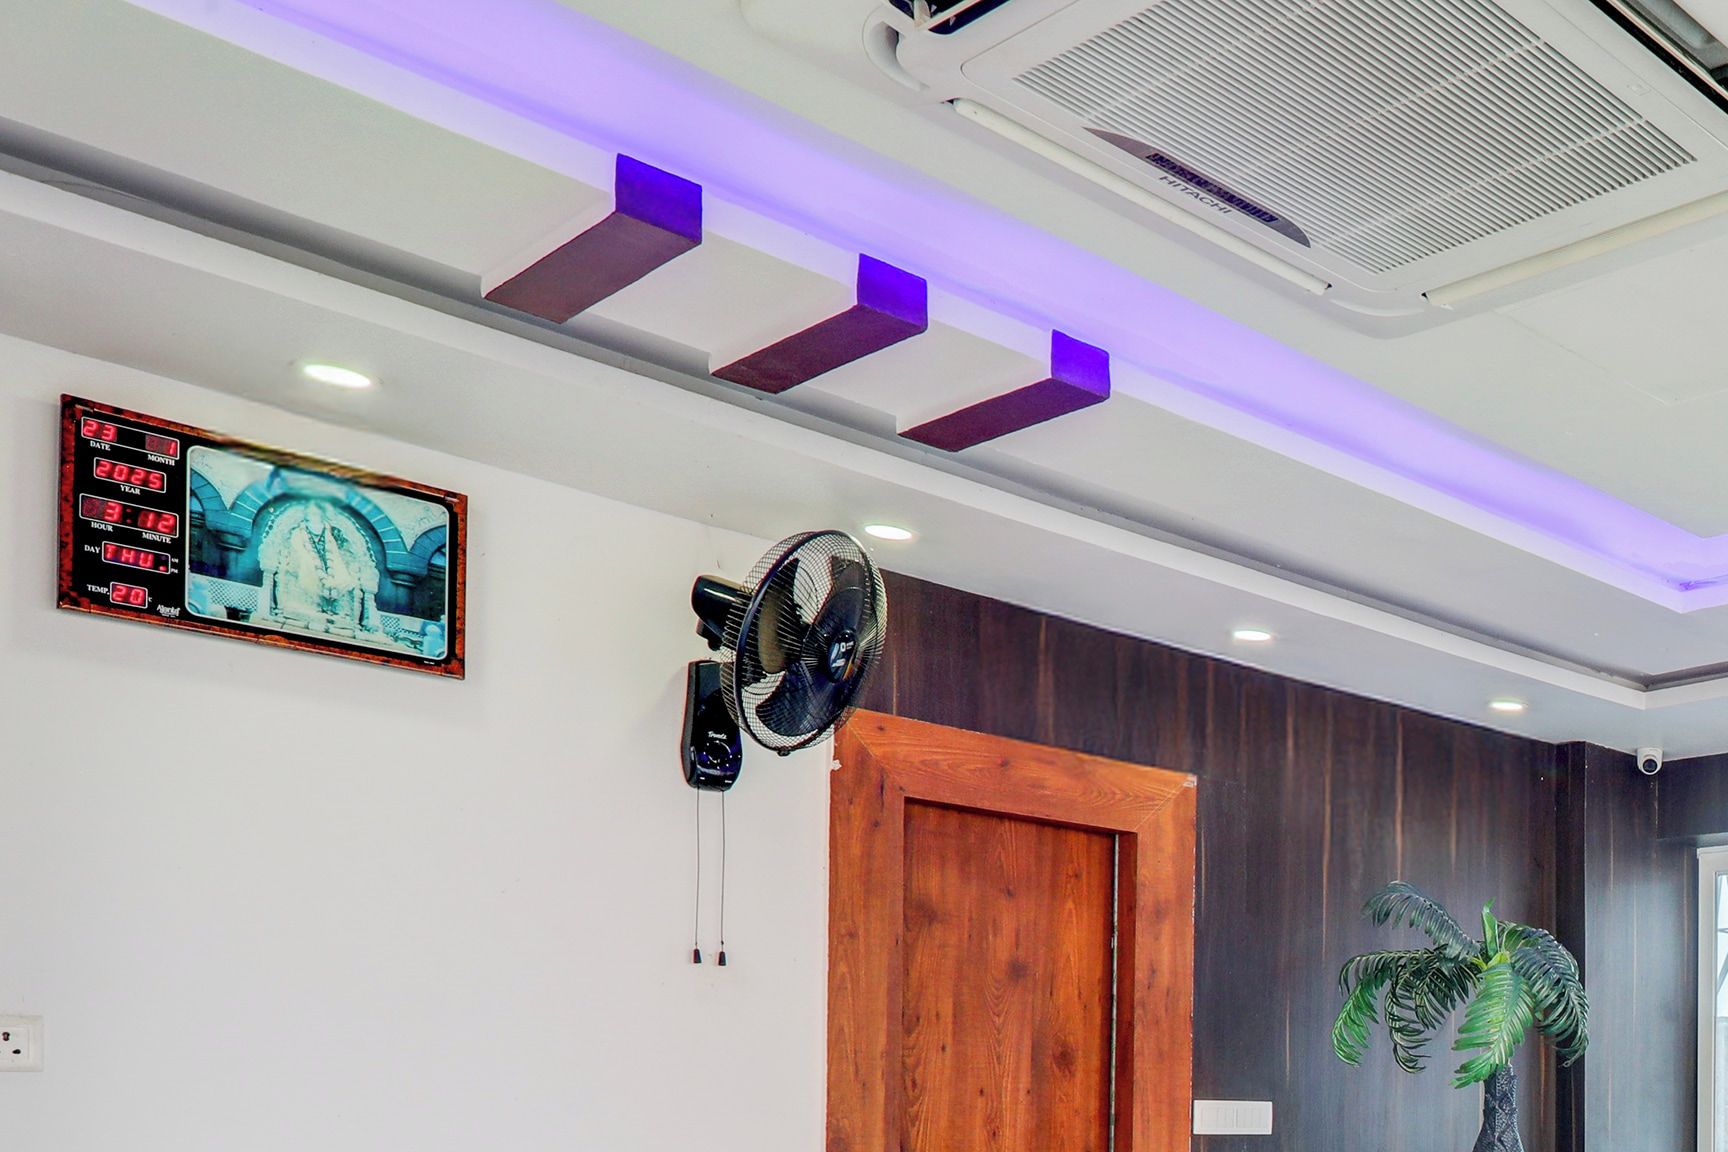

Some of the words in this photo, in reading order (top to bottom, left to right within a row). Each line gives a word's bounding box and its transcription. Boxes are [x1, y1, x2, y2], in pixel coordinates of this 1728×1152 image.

[1160, 176, 1232, 214] HITACHI
[83, 419, 117, 441] 23
[90, 441, 111, 451] DATE
[147, 454, 175, 466] MONTH
[96, 461, 162, 489] 2025
[120, 485, 140, 495] YEAR
[91, 522, 113, 532] HOUR
[142, 532, 171, 544] MINUTE
[84, 545, 100, 553] DAY
[87, 584, 110, 595] TEMP.
[112, 585, 145, 605] 20
